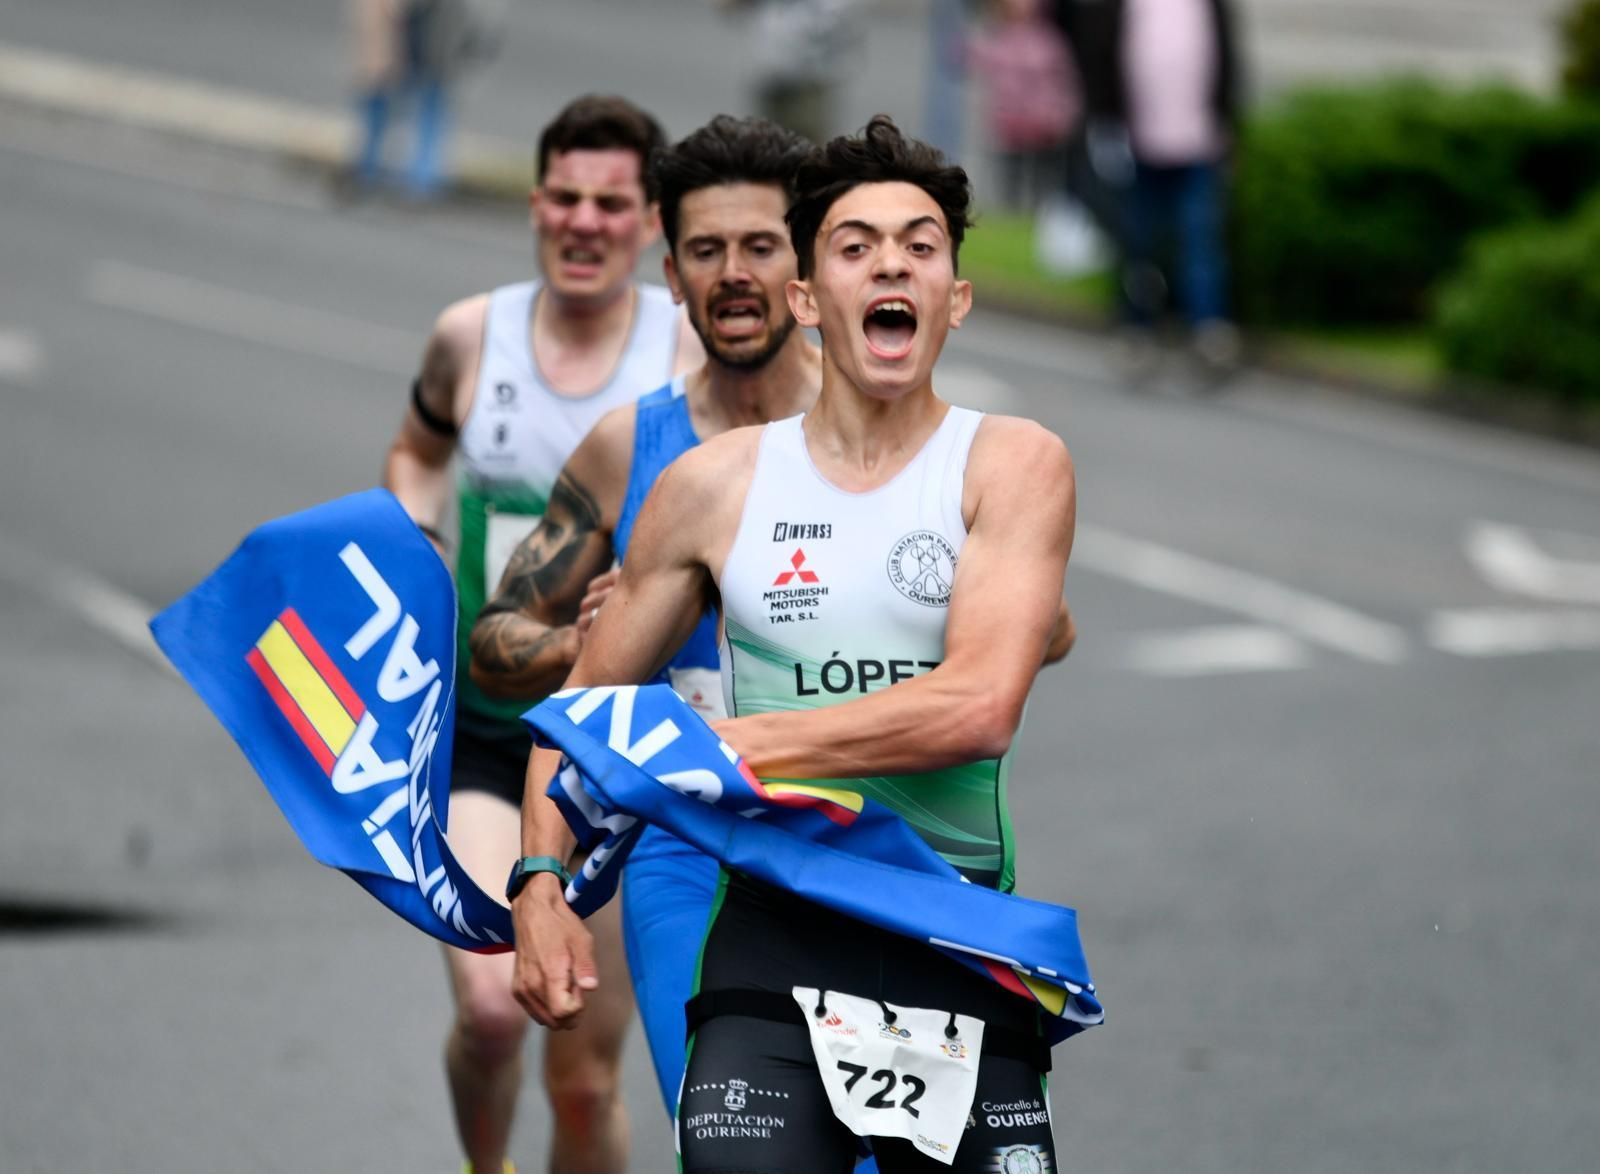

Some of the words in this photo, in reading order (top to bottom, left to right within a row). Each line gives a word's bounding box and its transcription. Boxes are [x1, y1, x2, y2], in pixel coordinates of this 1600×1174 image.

[890, 559, 904, 583] CLUB
[763, 587, 829, 601] MITSUBISHI
[770, 597, 820, 611] MOTORS
[837, 1060, 926, 1120] 722
[981, 1099, 1032, 1112] Concello
[686, 1112, 785, 1130] DEPUTACIÓN
[986, 1110, 1048, 1128] OURENSE
[696, 1126, 772, 1140] OURENSE
